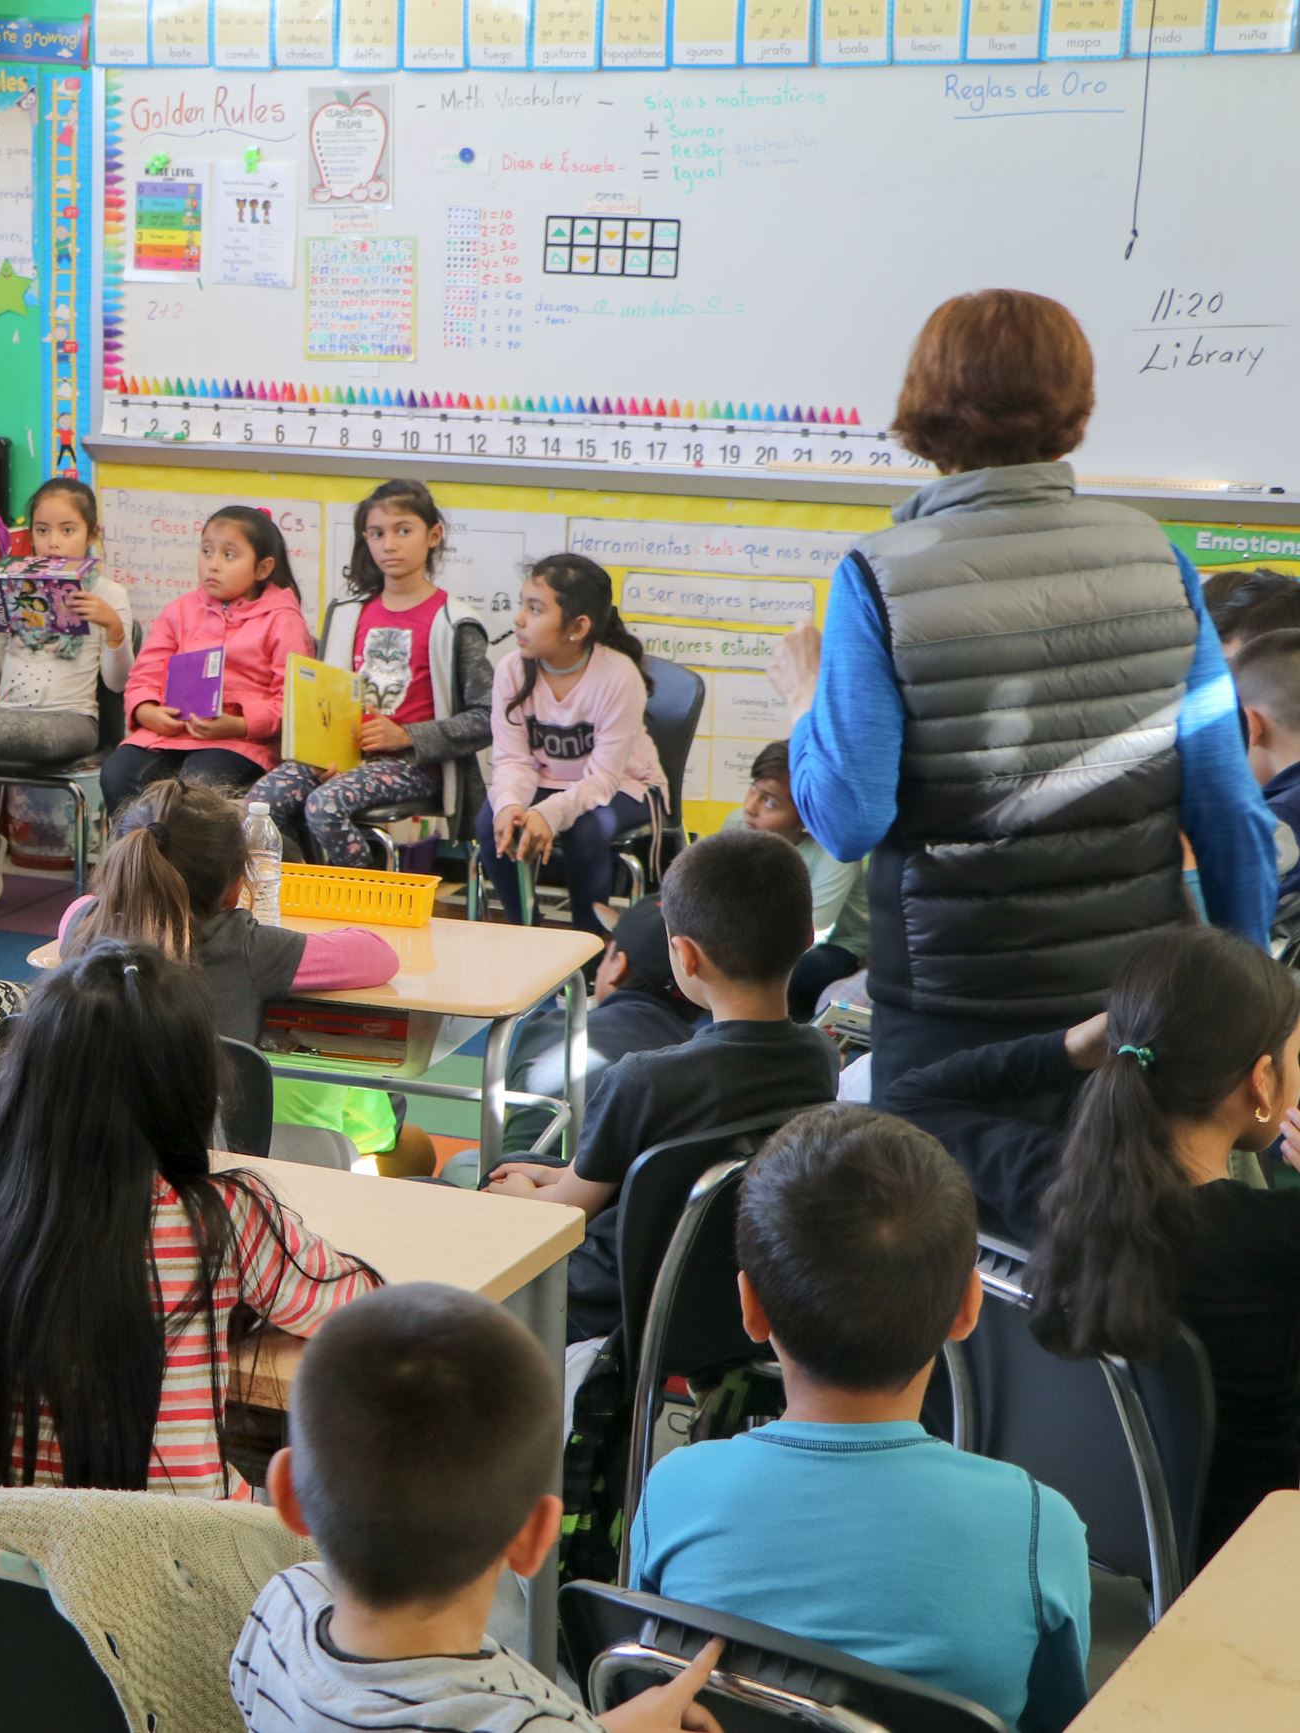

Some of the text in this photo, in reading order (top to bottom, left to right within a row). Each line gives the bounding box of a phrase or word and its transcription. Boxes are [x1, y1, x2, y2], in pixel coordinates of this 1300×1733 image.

[1154, 33, 1182, 44] nido
[1238, 30, 1267, 41] niña
[757, 43, 792, 60] jirafa
[838, 42, 869, 54] koala
[911, 40, 941, 52] limón
[988, 38, 1017, 51] llave
[1067, 37, 1101, 53] mapa
[169, 49, 192, 58] bate
[225, 50, 260, 60] camello
[286, 49, 324, 60] chaleco
[413, 49, 454, 60] elefante
[483, 49, 512, 64] fuego
[543, 48, 587, 63] guitarra
[603, 47, 664, 64] hipopótamo
[686, 47, 724, 61] iguana
[440, 79, 583, 111] Math Vocabulary
[944, 69, 1108, 112] Reglas de Oro
[130, 83, 286, 132] Golden Rules
[668, 122, 726, 140] Sumar
[539, 150, 616, 173] de Escuela
[672, 163, 724, 194] Igual
[1151, 287, 1224, 323] 11:20
[1137, 335, 1264, 377] Library
[121, 417, 128, 434] 1
[212, 421, 222, 439] 4
[243, 423, 253, 442] 5
[275, 425, 285, 443] 6
[307, 426, 317, 445] 7
[339, 427, 350, 447] 8
[371, 428, 382, 448] 9
[400, 430, 420, 450] 10
[434, 432, 452, 452] 11
[467, 433, 487, 453] 12
[506, 435, 526, 455] 13
[541, 437, 561, 457] 14
[576, 438, 596, 458] 15
[611, 440, 632, 460] 16
[647, 442, 667, 461] 17
[719, 445, 741, 464] 19
[150, 518, 188, 535] Class
[571, 531, 802, 568] Herramientas tools que nos
[626, 584, 814, 615] a ser mejores personas
[644, 635, 714, 662] mejores
[731, 696, 770, 709] Listening
